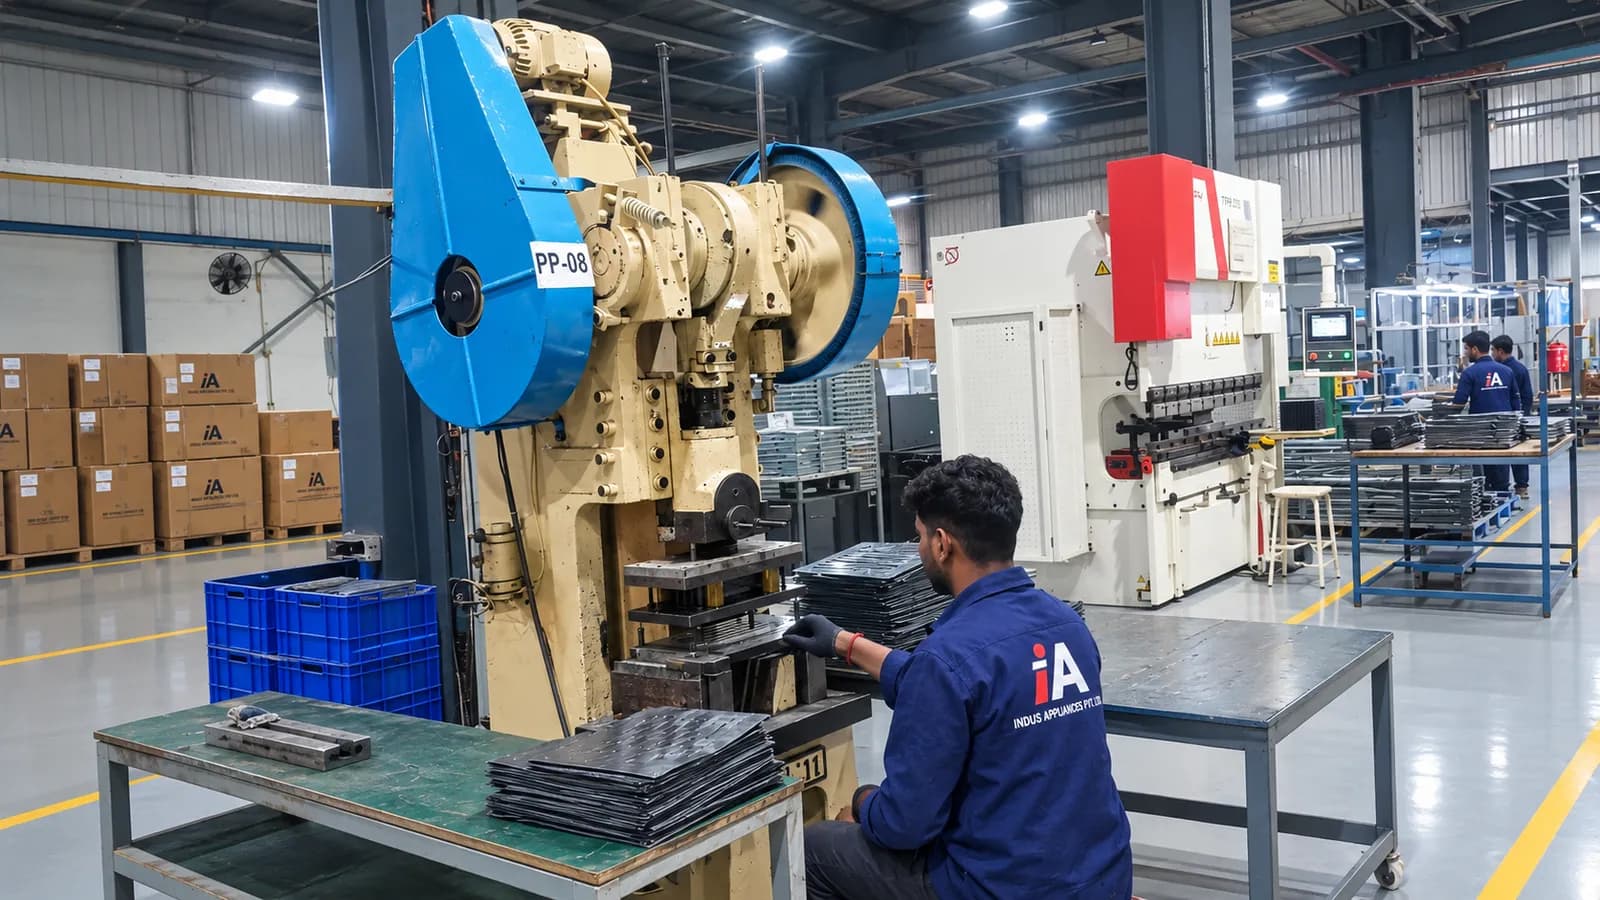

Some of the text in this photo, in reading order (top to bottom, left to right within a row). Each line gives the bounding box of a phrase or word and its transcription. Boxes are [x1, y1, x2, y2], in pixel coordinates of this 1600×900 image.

[535, 252, 588, 274] PP-08
[201, 373, 220, 388] iA
[1485, 372, 1503, 387] iA
[204, 425, 222, 440] iA
[205, 479, 224, 495] iA
[309, 472, 325, 487] iA
[1032, 642, 1090, 706] iA
[1013, 712, 1042, 729] INDUS
[1044, 701, 1083, 721] APPLIANCES
